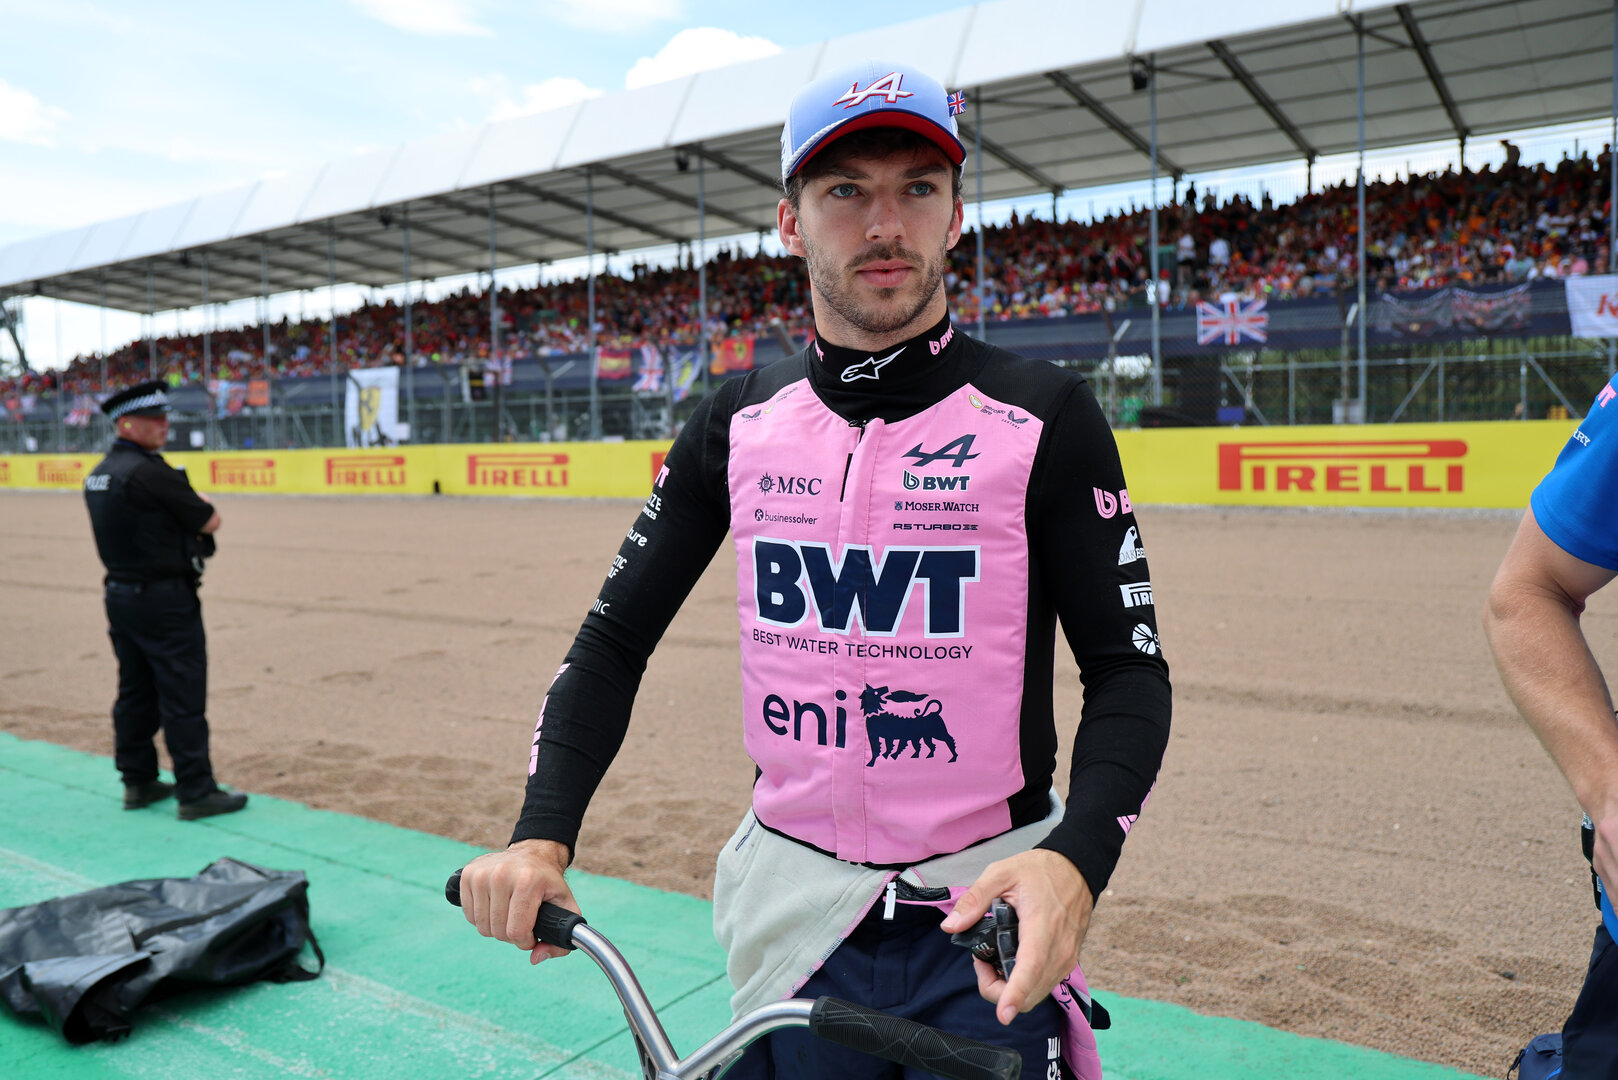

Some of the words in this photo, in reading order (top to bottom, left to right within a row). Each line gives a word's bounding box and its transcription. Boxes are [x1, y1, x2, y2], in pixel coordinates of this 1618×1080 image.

[210, 459, 276, 486] PIRELLI
[325, 456, 406, 486] PIRELLI
[466, 454, 570, 487] PIRELLI
[1218, 440, 1468, 493] PIRELLI
[776, 476, 822, 496] MSC
[922, 475, 970, 491] BWT
[764, 510, 818, 525] businessolver
[753, 535, 981, 639] BWT
[753, 628, 782, 646] BEST
[786, 636, 839, 655] WATER
[845, 642, 973, 660] TECHNOLOGY
[763, 689, 847, 749] eni
